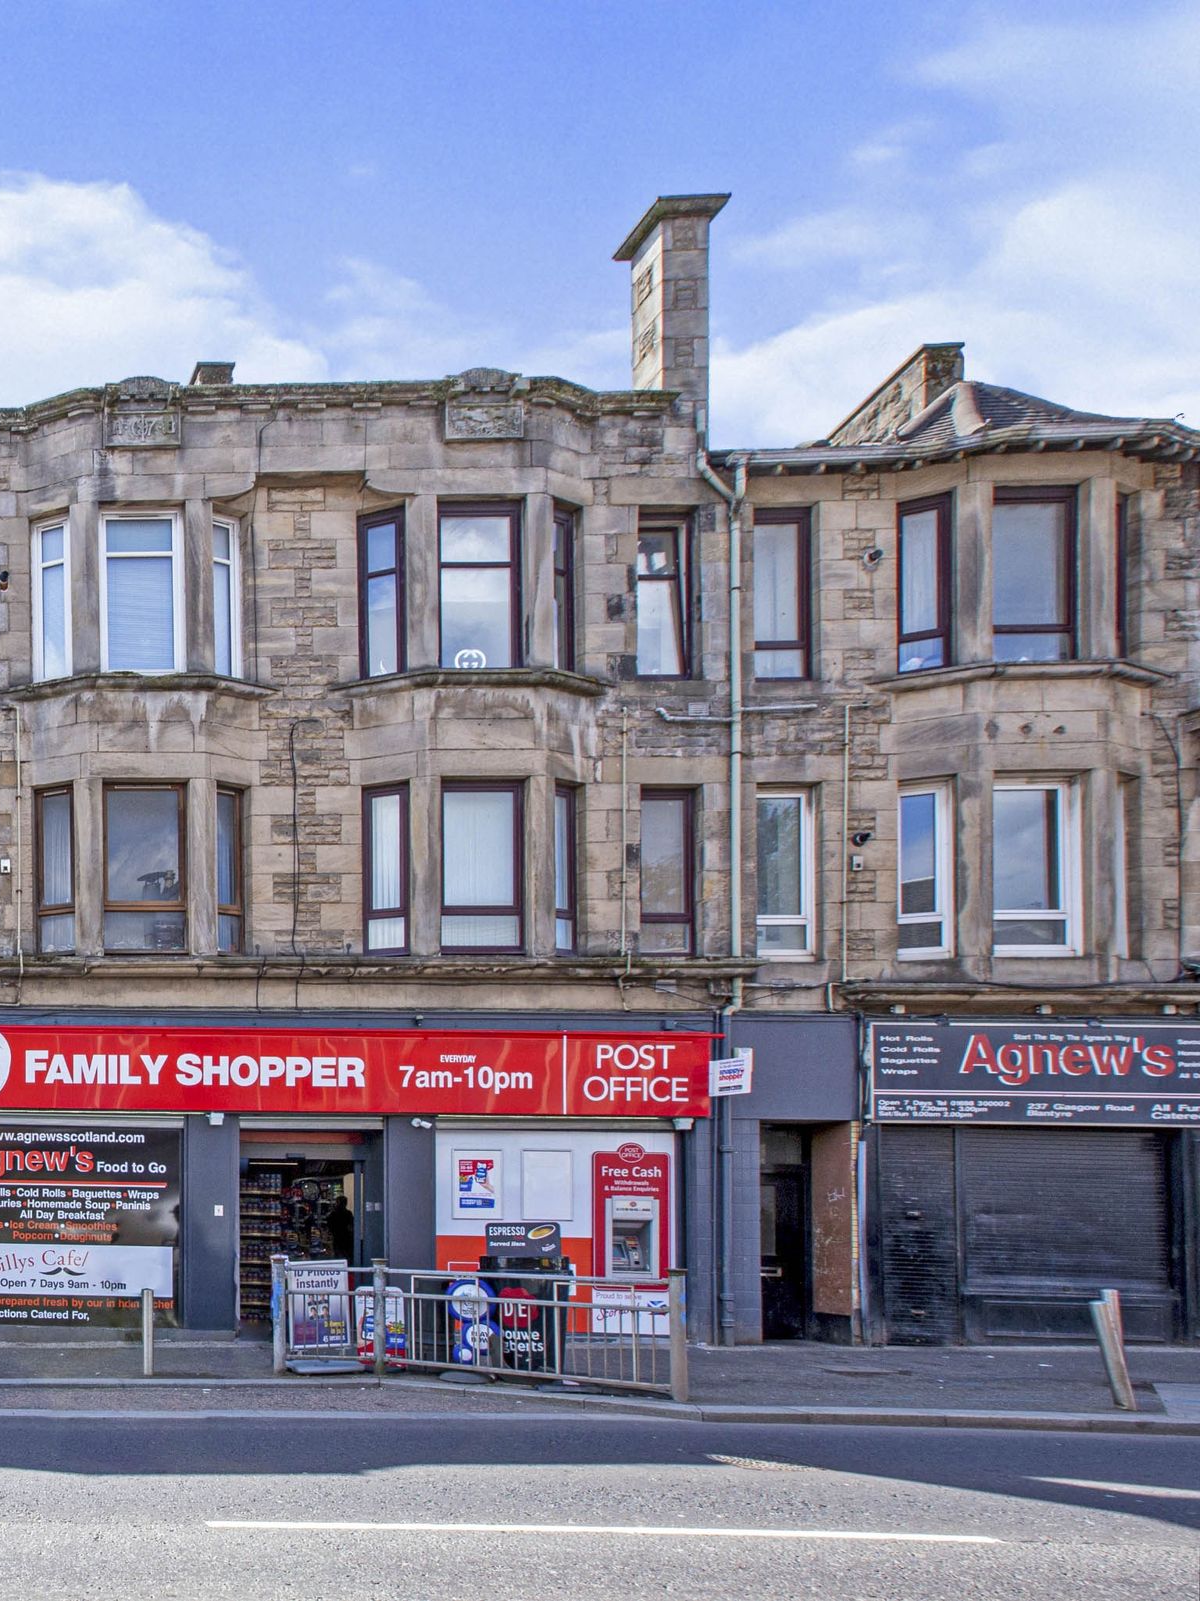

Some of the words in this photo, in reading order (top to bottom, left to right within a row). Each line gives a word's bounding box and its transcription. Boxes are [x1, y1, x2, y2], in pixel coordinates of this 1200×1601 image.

[440, 1054, 477, 1064] EVERYDAY
[596, 1043, 675, 1071] POST
[958, 1032, 1175, 1086] Agnew's
[25, 1050, 169, 1085] FAMILY
[175, 1053, 366, 1088] SHOPPER
[881, 1068, 919, 1076] Wraps
[399, 1065, 533, 1094] 7am-10pm
[583, 1075, 689, 1102] OFFICE
[878, 1099, 901, 1107] Open
[912, 1099, 933, 1107] Days
[1105, 1104, 1135, 1112] Road
[1026, 1109, 1073, 1118] Blantyre
[96, 1161, 129, 1174] Food
[132, 1162, 145, 1173] to
[148, 1162, 167, 1174] Go
[601, 1165, 629, 1177] Free
[632, 1166, 662, 1178] Cash
[16, 1187, 39, 1198] Cold
[42, 1188, 66, 1198] Rolls
[72, 1188, 122, 1201] Baguettes
[127, 1189, 160, 1201] Wraps
[27, 1199, 82, 1209] Homemade
[85, 1200, 111, 1211] Soup
[116, 1201, 151, 1211] Paninis
[19, 1210, 33, 1219] All
[35, 1211, 54, 1221] Day
[57, 1211, 105, 1220] Breakfast
[9, 1220, 25, 1229] Ice
[27, 1220, 59, 1230] Cream
[65, 1221, 118, 1231] Smoothies
[489, 1226, 525, 1236] ESPRESSO
[12, 1231, 54, 1241] Popcorn
[60, 1231, 112, 1243] Doughnuts
[0, 1278, 27, 1290] Open
[30, 1278, 37, 1288] 7
[40, 1279, 65, 1290] Days
[67, 1280, 89, 1289] 9am
[100, 1280, 127, 1291] 10pm
[296, 1277, 339, 1290] instantly
[43, 1298, 69, 1308] fresh
[72, 1299, 84, 1309] by
[86, 1300, 103, 1308] our
[106, 1298, 115, 1308] in
[153, 1299, 175, 1309] chef
[30, 1309, 68, 1319] Catered
[72, 1310, 90, 1321] For,
[502, 1330, 540, 1340] ouwe
[502, 1340, 544, 1354] gberts
